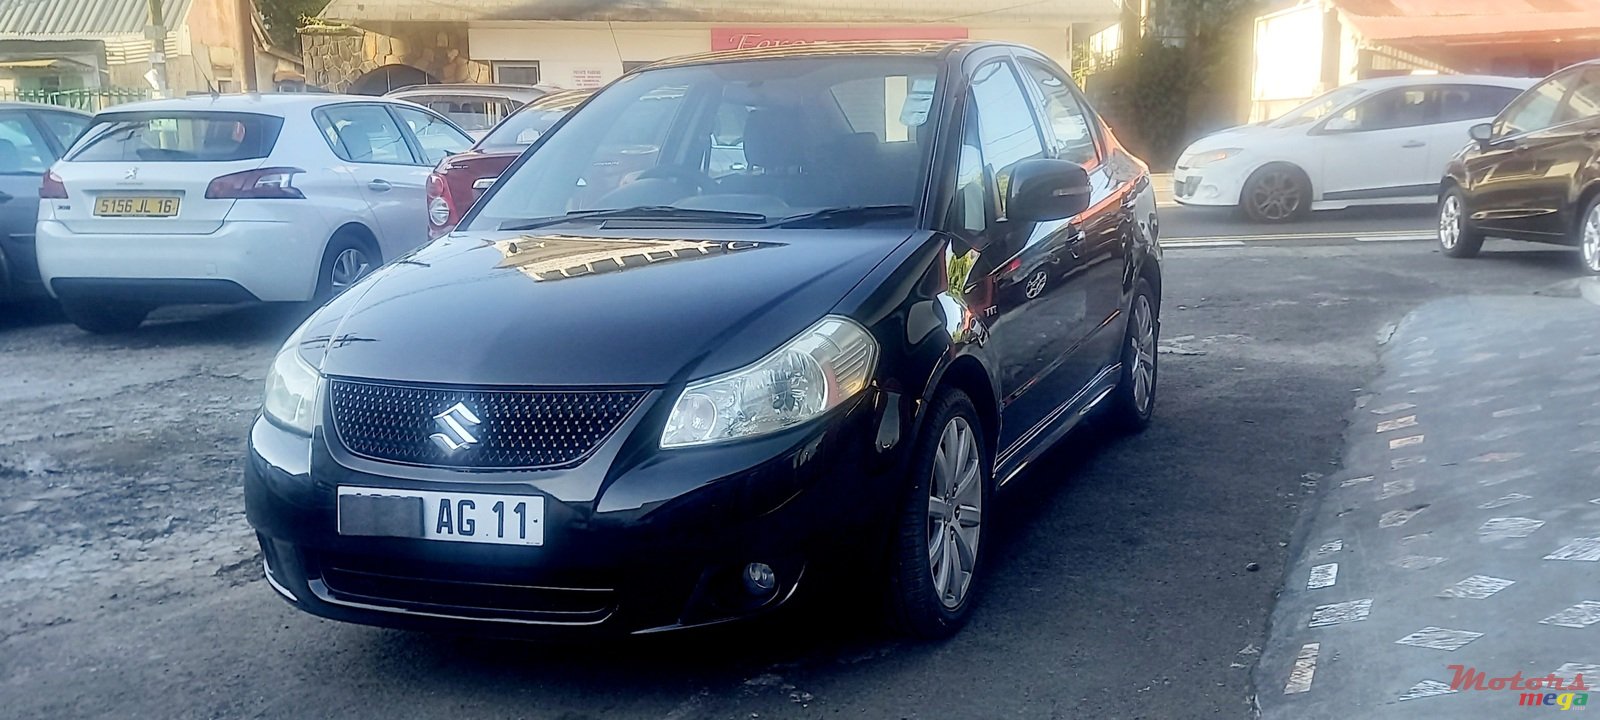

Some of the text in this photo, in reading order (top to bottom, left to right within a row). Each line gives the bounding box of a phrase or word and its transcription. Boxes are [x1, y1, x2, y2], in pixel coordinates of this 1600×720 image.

[100, 199, 173, 213] 5156 JL 16
[436, 498, 476, 536] AG
[492, 501, 526, 539] 11
